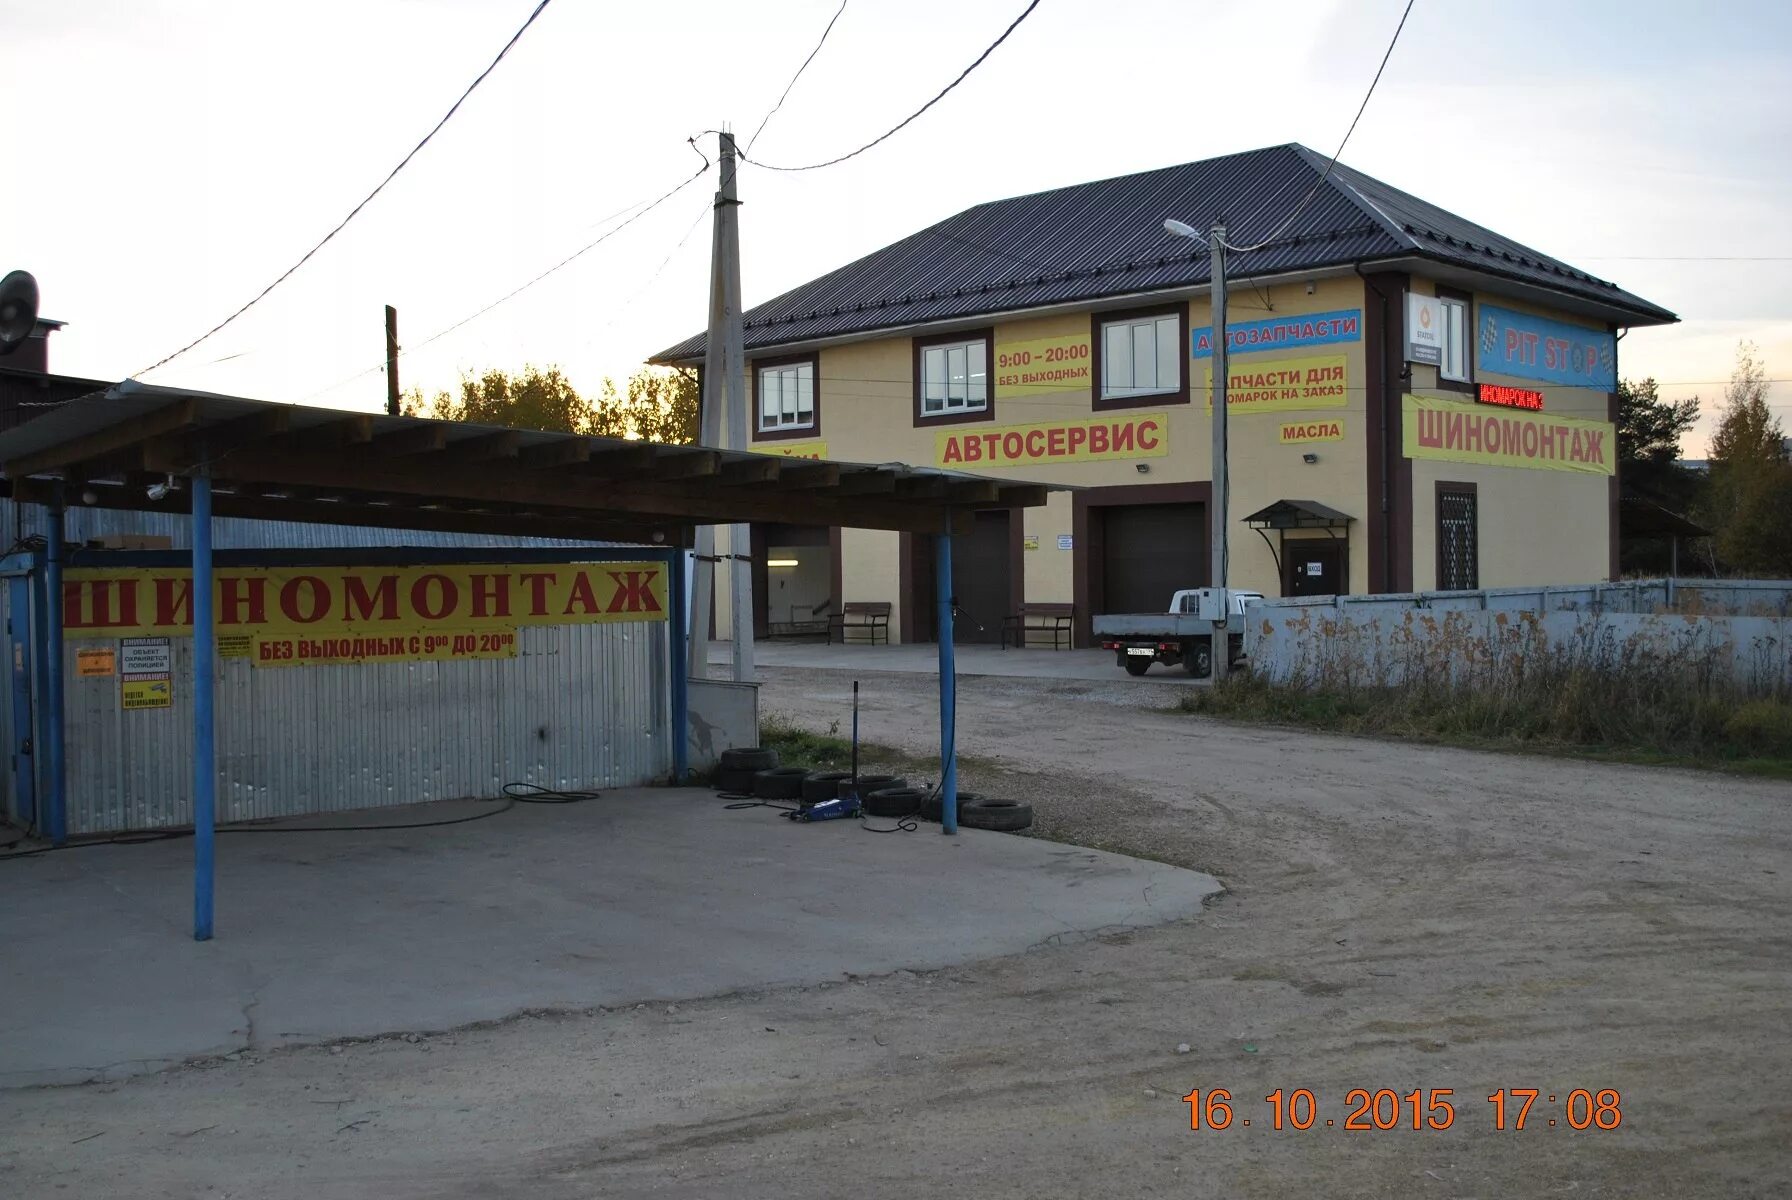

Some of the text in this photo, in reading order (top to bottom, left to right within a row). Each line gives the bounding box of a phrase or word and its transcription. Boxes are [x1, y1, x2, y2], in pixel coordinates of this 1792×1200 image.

[1197, 316, 1357, 350] АТОЗАПЧАСТИ
[999, 351, 1031, 368] 9:00
[1045, 344, 1089, 363] 20:00
[1505, 328, 1598, 376] PIT STOP
[999, 367, 1089, 386] БЕЗ ВЫХОДНЫХ
[1209, 366, 1344, 391] ПЧАСТИ ДЛЯ
[1209, 384, 1344, 406] ОМАРОК НА ЗАКАЗ
[1480, 384, 1526, 407] ИНОМАРОК
[1527, 391, 1538, 409] НА
[943, 420, 1159, 464] АВТОСЕРВИС
[1283, 423, 1340, 440] МАСЛА
[1417, 407, 1605, 465] ШИНОМОНТАЖ
[62, 570, 662, 628] ШИНОМОНТАЖ
[123, 637, 168, 646] ВНИМАНИЕ!
[259, 640, 293, 661] БЕЗ
[300, 634, 406, 660] ВЫХОДНЫХ
[408, 636, 420, 654] С
[452, 636, 477, 656] ДО
[124, 673, 169, 682] ВНИМАНИЕ!
